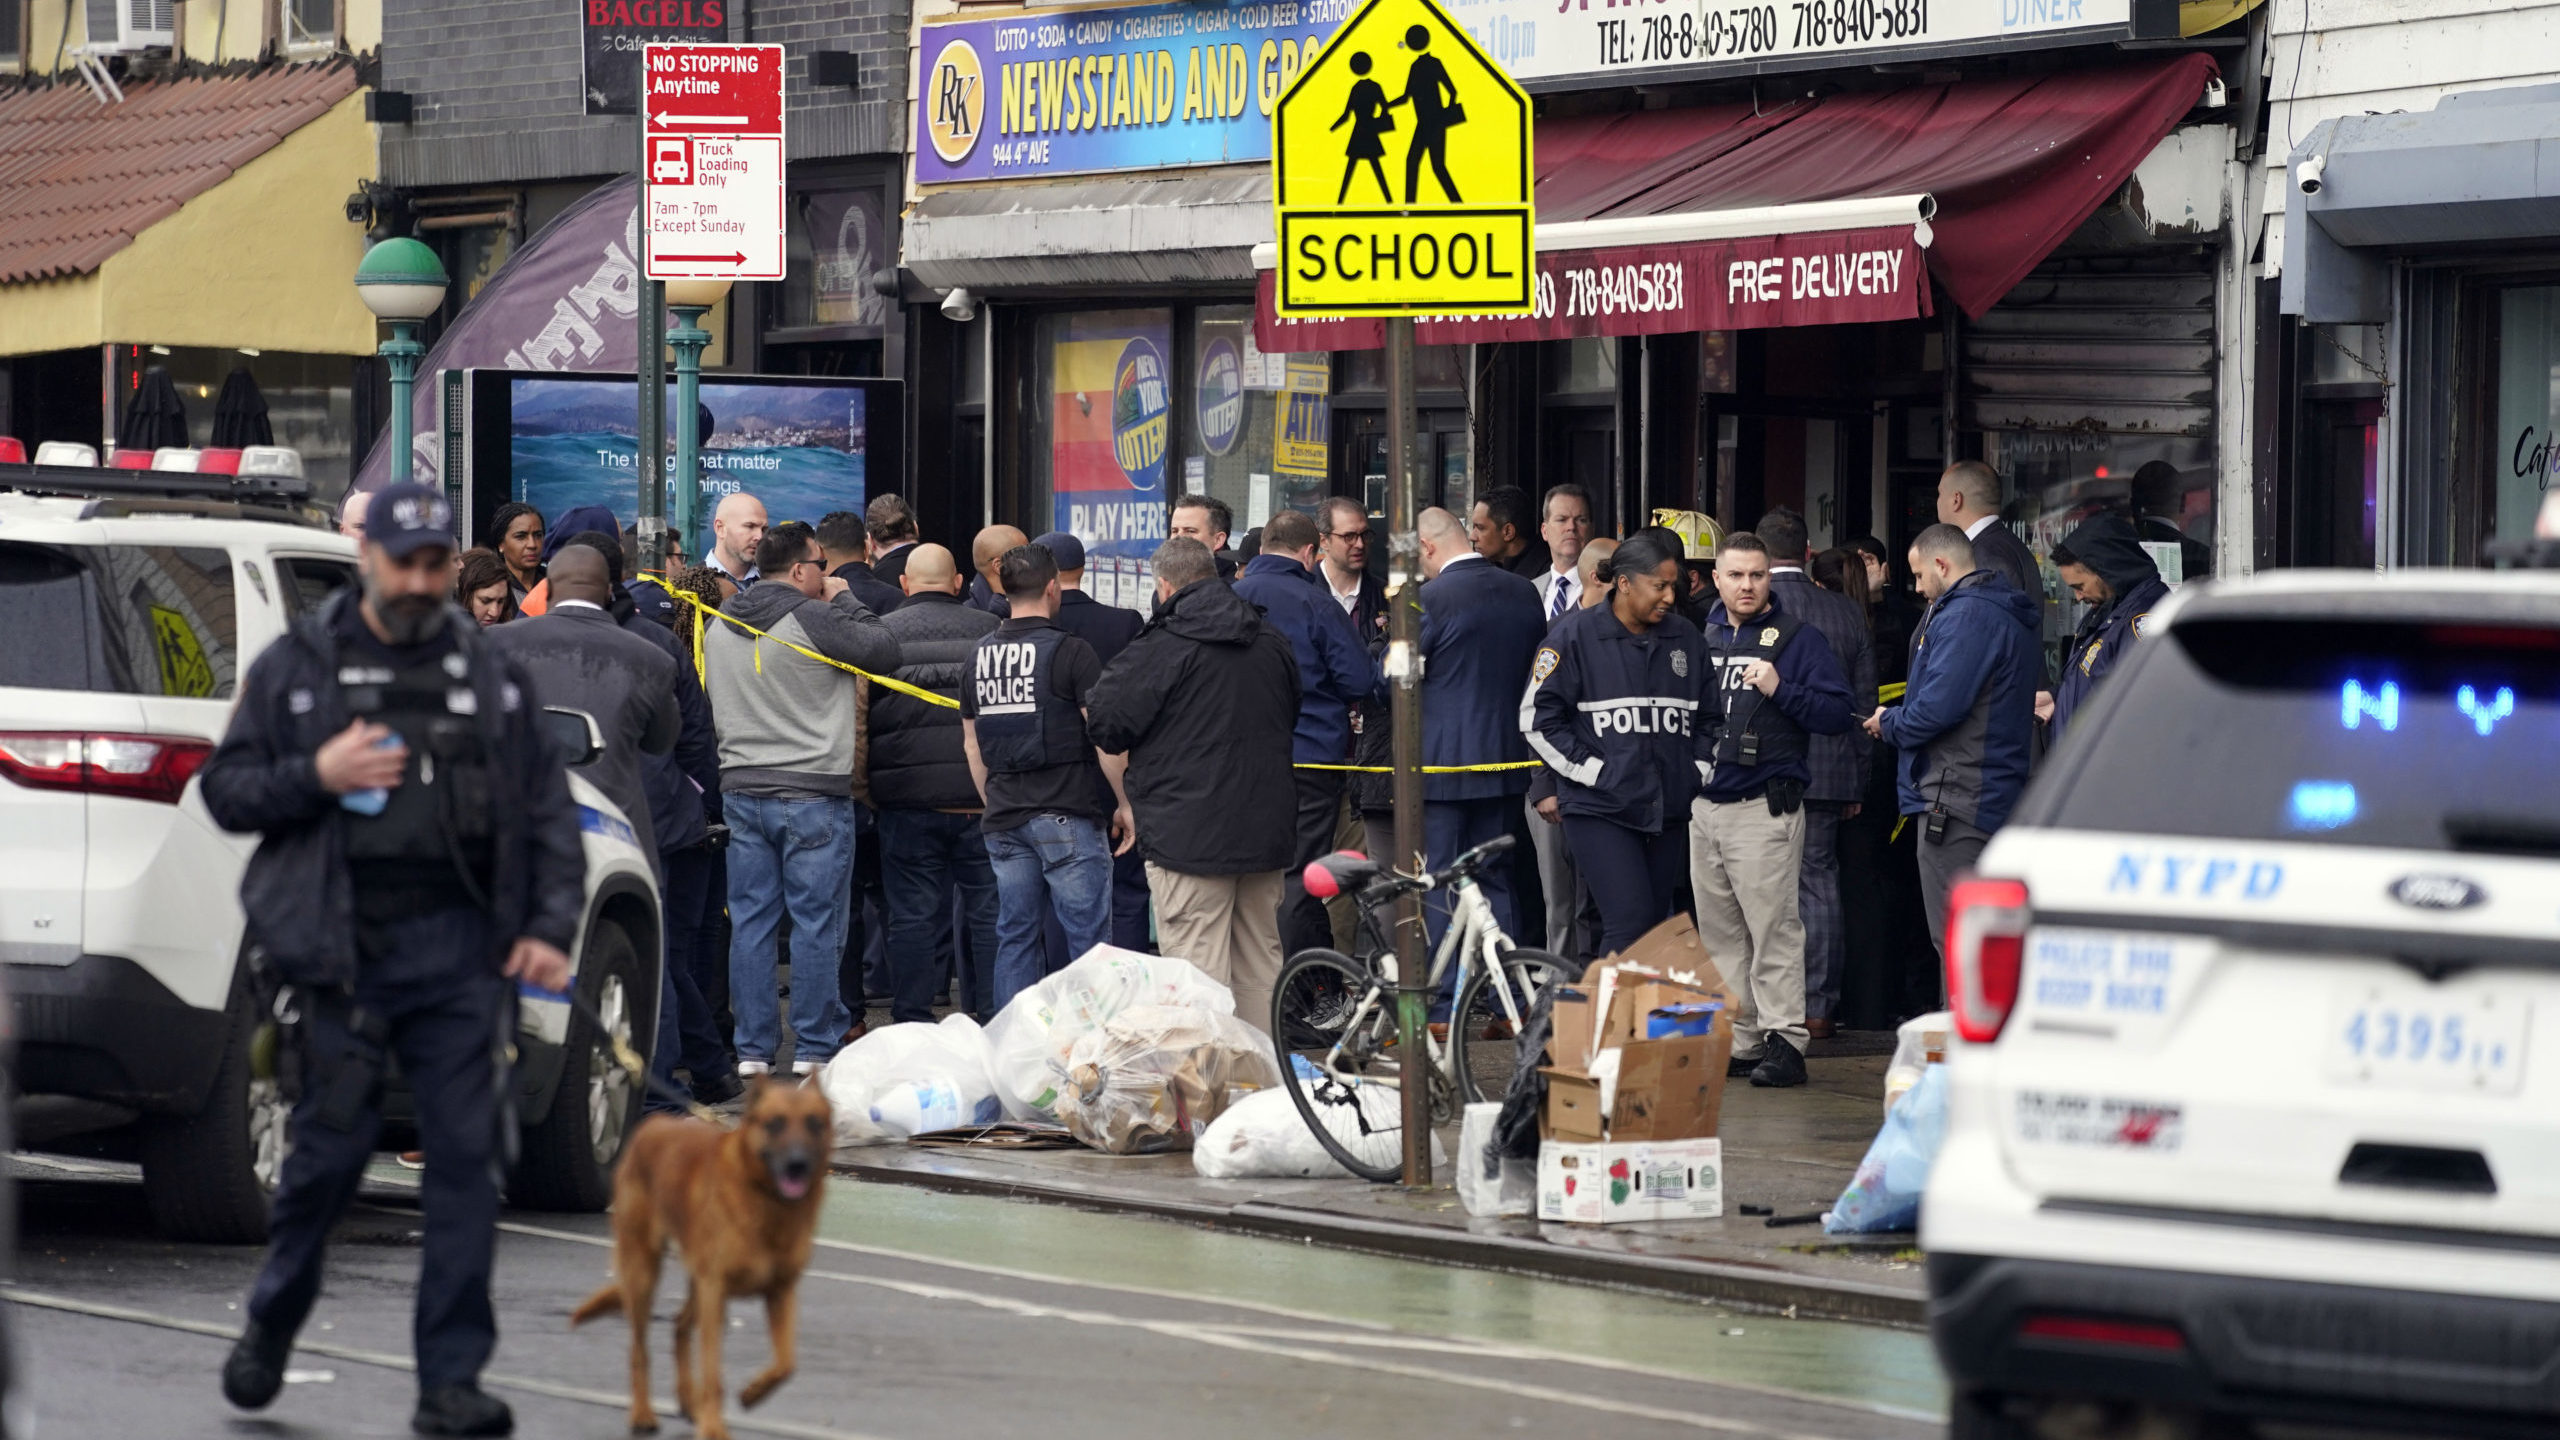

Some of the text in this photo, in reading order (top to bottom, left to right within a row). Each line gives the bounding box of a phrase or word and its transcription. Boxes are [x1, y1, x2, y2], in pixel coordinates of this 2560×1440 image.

[588, 0, 723, 27] BAGELS
[995, 27, 1028, 52] LOTTO
[1037, 25, 1066, 49] SODA
[1076, 20, 1114, 45] CANDY
[1123, 13, 1185, 41] CIGARETTES
[1195, 9, 1229, 34] CIGAR
[1239, 6, 1269, 30] COLD
[1272, 2, 1299, 27] BEER
[1597, 0, 1928, 65] TEL: 718-840-5780 718-840-5831
[653, 55, 759, 73] NO STOPPING
[653, 77, 720, 97] Anytime
[1000, 49, 1176, 135] NEWSSTAND
[1183, 43, 1248, 120] AND
[699, 142, 733, 156] Truck
[993, 143, 1012, 166] 944
[1028, 140, 1049, 164] AVE
[699, 158, 748, 172] Loading
[699, 172, 727, 188] Only
[654, 201, 679, 215] 7am
[692, 201, 718, 218] 7pm
[654, 219, 746, 236] Except Sunday
[1298, 232, 1514, 282] SCHOOL
[1565, 261, 1683, 317] 718-8405831
[1792, 249, 1903, 300] DELIVERY
[1137, 355, 1158, 380] NEW
[1138, 380, 1165, 416] YORK
[1285, 391, 1328, 443] ATM
[597, 450, 630, 467] The
[728, 454, 782, 470] matter
[1071, 502, 1167, 541] PLAY HERE
[976, 643, 1036, 680] NYPD
[976, 677, 1035, 705] POLICE
[1592, 707, 1691, 738] POLICE
[2108, 853, 2285, 901] NYPD
